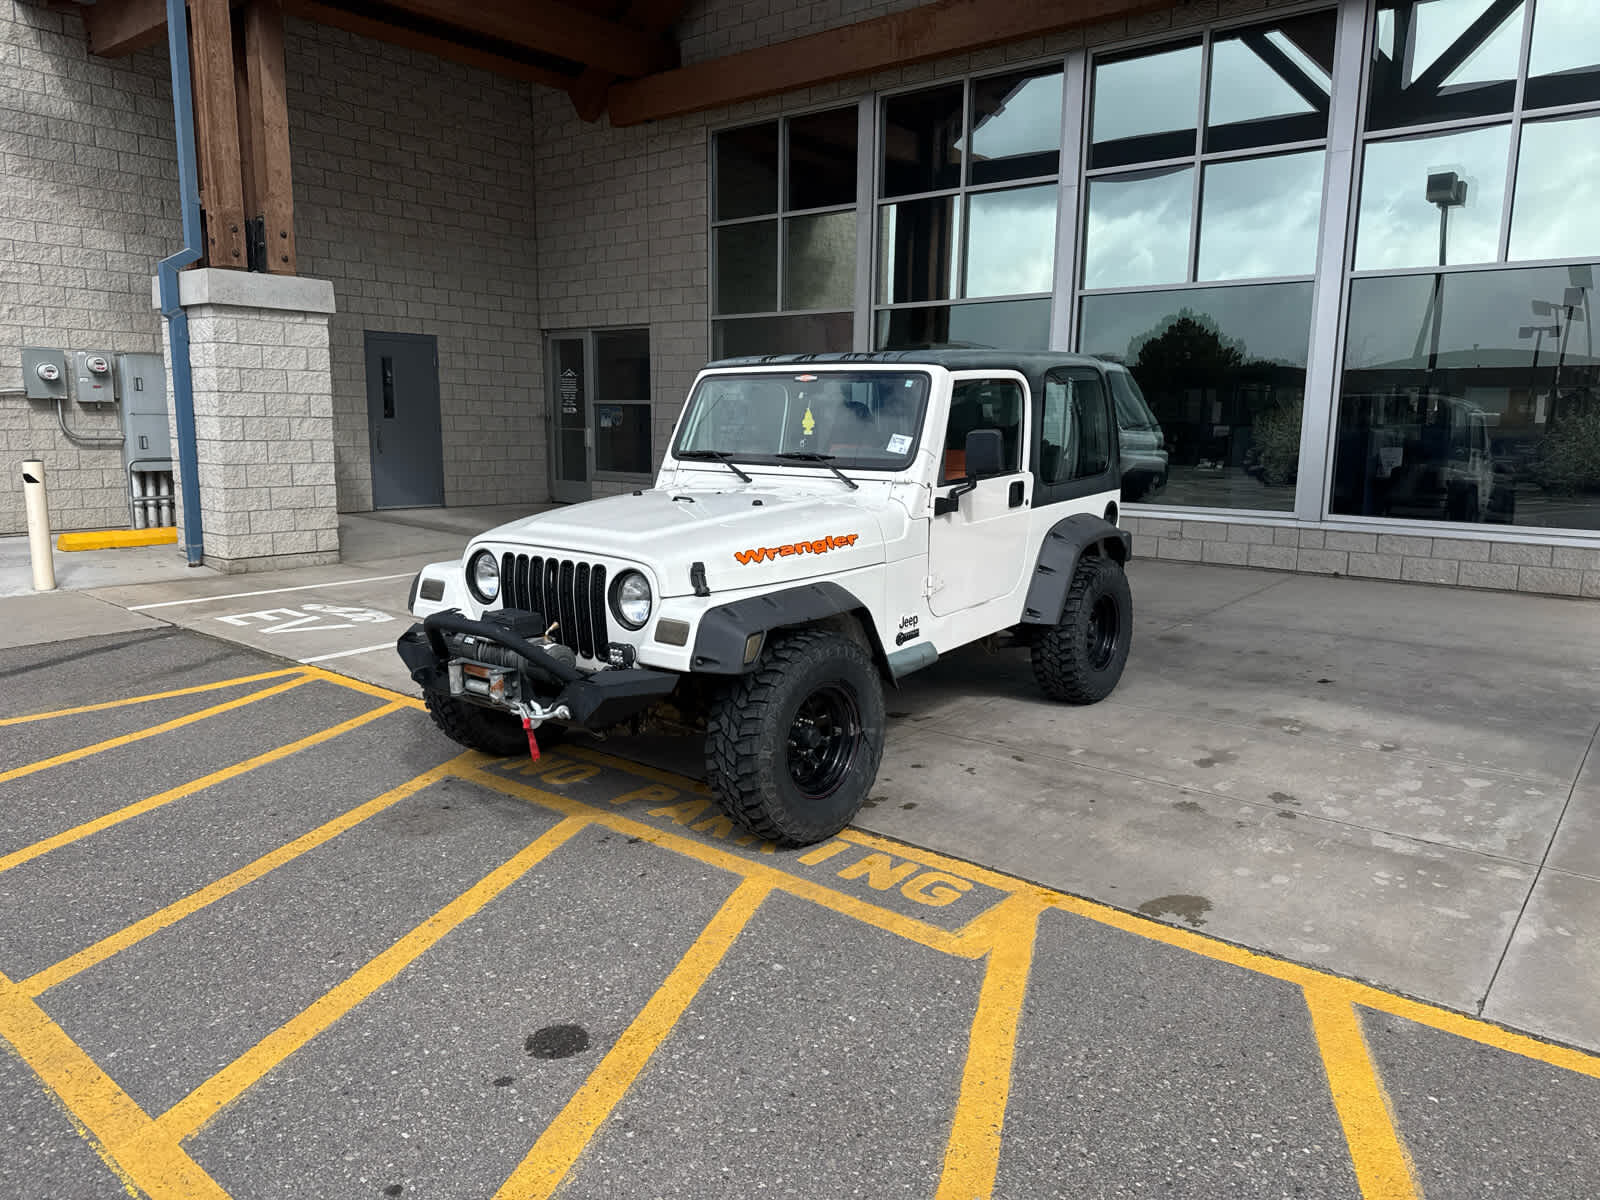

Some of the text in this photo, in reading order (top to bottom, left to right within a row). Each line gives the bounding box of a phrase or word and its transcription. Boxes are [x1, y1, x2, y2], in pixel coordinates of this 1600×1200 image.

[734, 533, 858, 565] Wrangler
[215, 608, 357, 634] EV
[899, 615, 919, 629] Jeep
[500, 753, 973, 907] NO PARING
